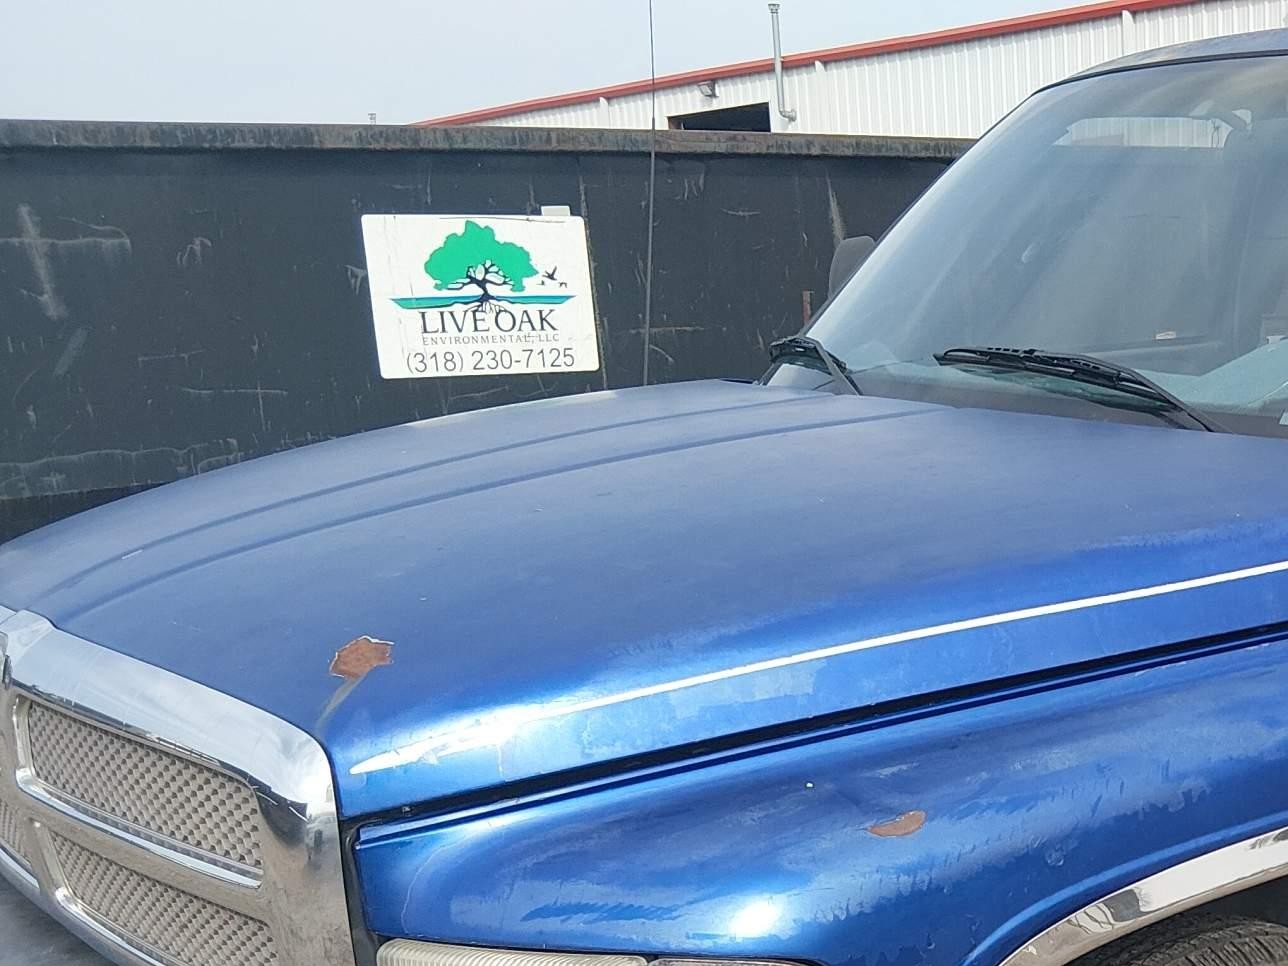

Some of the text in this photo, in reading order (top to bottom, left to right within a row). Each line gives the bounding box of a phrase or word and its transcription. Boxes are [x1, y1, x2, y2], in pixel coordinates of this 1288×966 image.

[420, 309, 559, 334] LIVE OAK
[538, 333, 560, 343] LLC
[406, 347, 575, 374] (318) 230-7125
